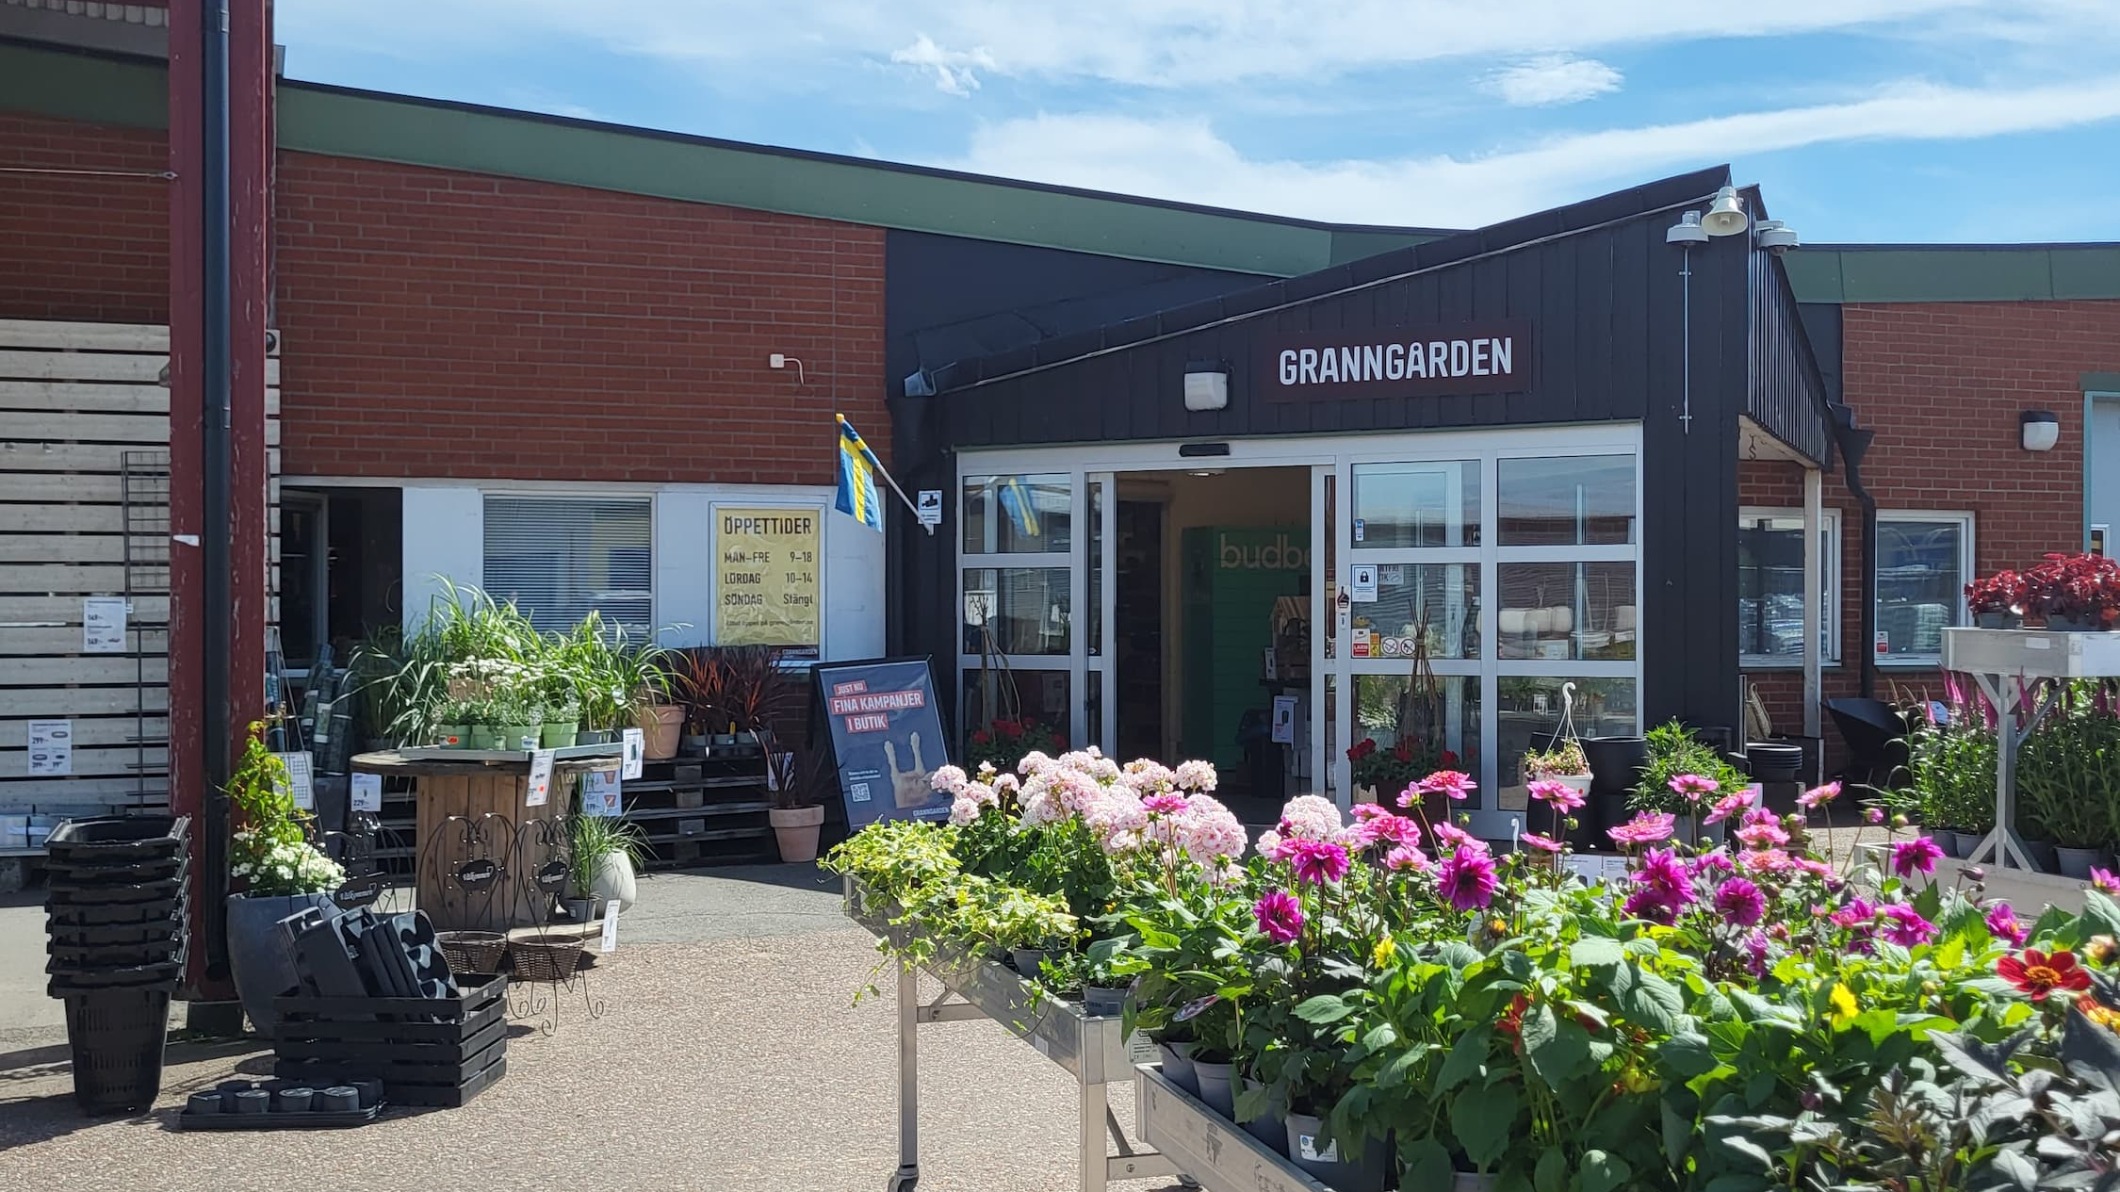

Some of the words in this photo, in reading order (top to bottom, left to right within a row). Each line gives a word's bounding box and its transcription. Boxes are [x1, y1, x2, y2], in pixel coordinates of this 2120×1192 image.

[1279, 337, 1512, 386] GRANNGÅRDEN
[724, 516, 812, 534] ÖPPETTIDER
[790, 551, 812, 563] 9–18
[724, 572, 761, 584] LÖRDAG
[785, 572, 813, 584] 10–14
[724, 593, 763, 605] SÖNDAG
[838, 684, 853, 694] JUST
[853, 682, 864, 691] NU
[833, 698, 859, 713] FINA
[860, 693, 922, 710] KAMPANJER
[848, 718, 853, 731] I
[854, 715, 887, 730] BUTIK
